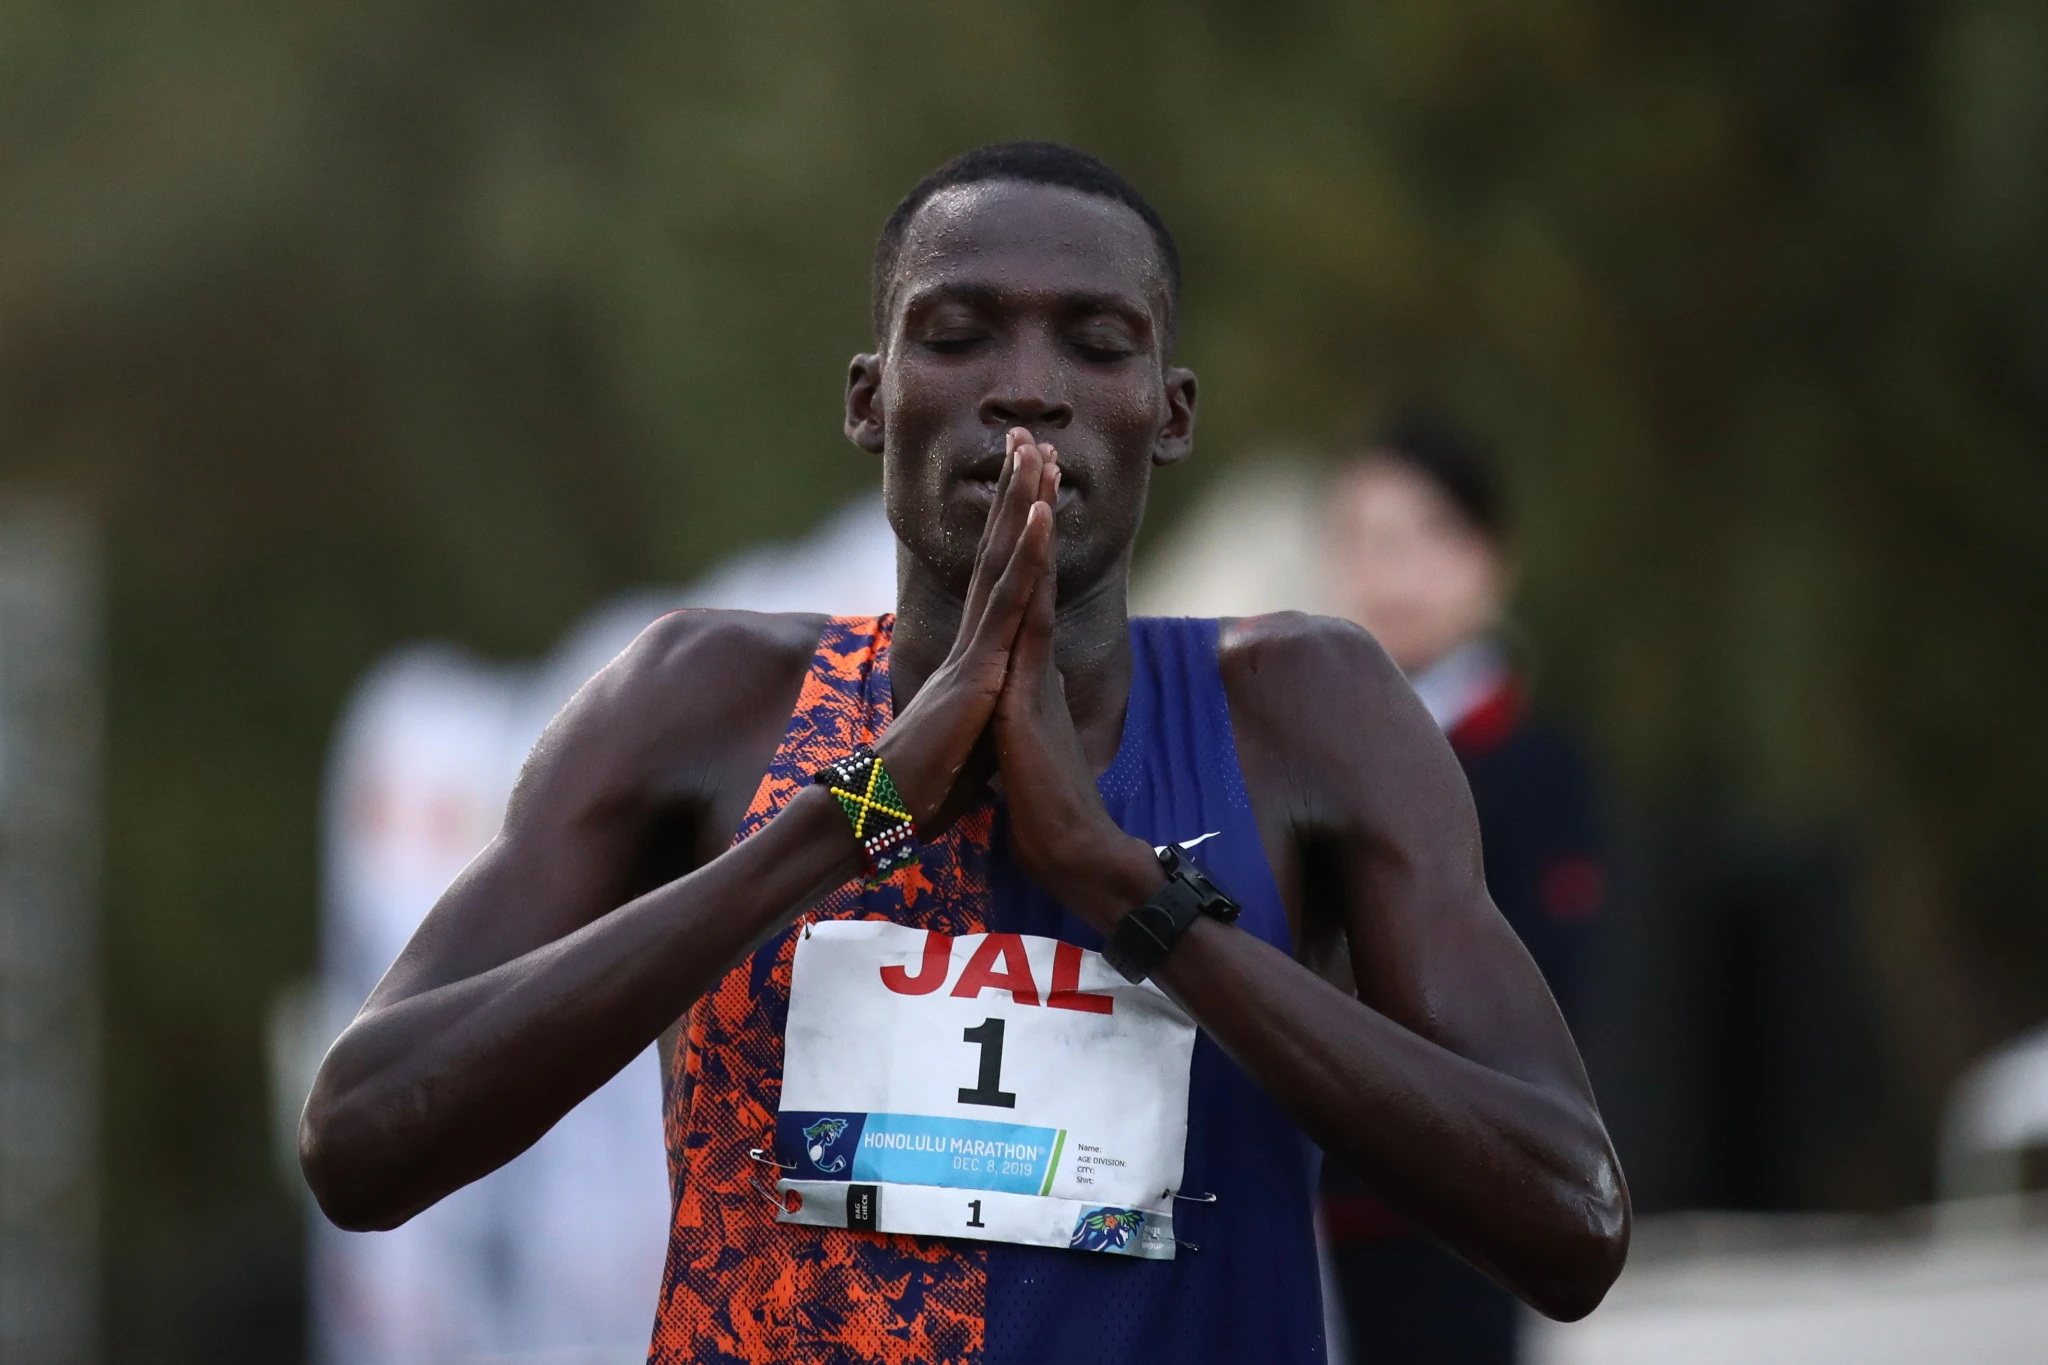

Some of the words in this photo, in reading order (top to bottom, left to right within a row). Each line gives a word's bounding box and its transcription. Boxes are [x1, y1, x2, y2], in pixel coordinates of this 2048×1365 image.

[879, 929, 1114, 1015] JAL
[957, 1017, 1016, 1109] 1
[864, 1132, 946, 1153] HONOLULU
[949, 1138, 1038, 1161] MARATHON
[1078, 1143, 1102, 1153] Name:
[953, 1156, 982, 1171] DEC.
[986, 1160, 998, 1174] 8,
[1002, 1161, 1033, 1176] 2019
[1076, 1165, 1095, 1174] CITY:
[1077, 1155, 1091, 1163] AGE
[1093, 1157, 1127, 1168] DIVISION:
[1076, 1175, 1094, 1184] Shirt:
[966, 1199, 985, 1228] 1
